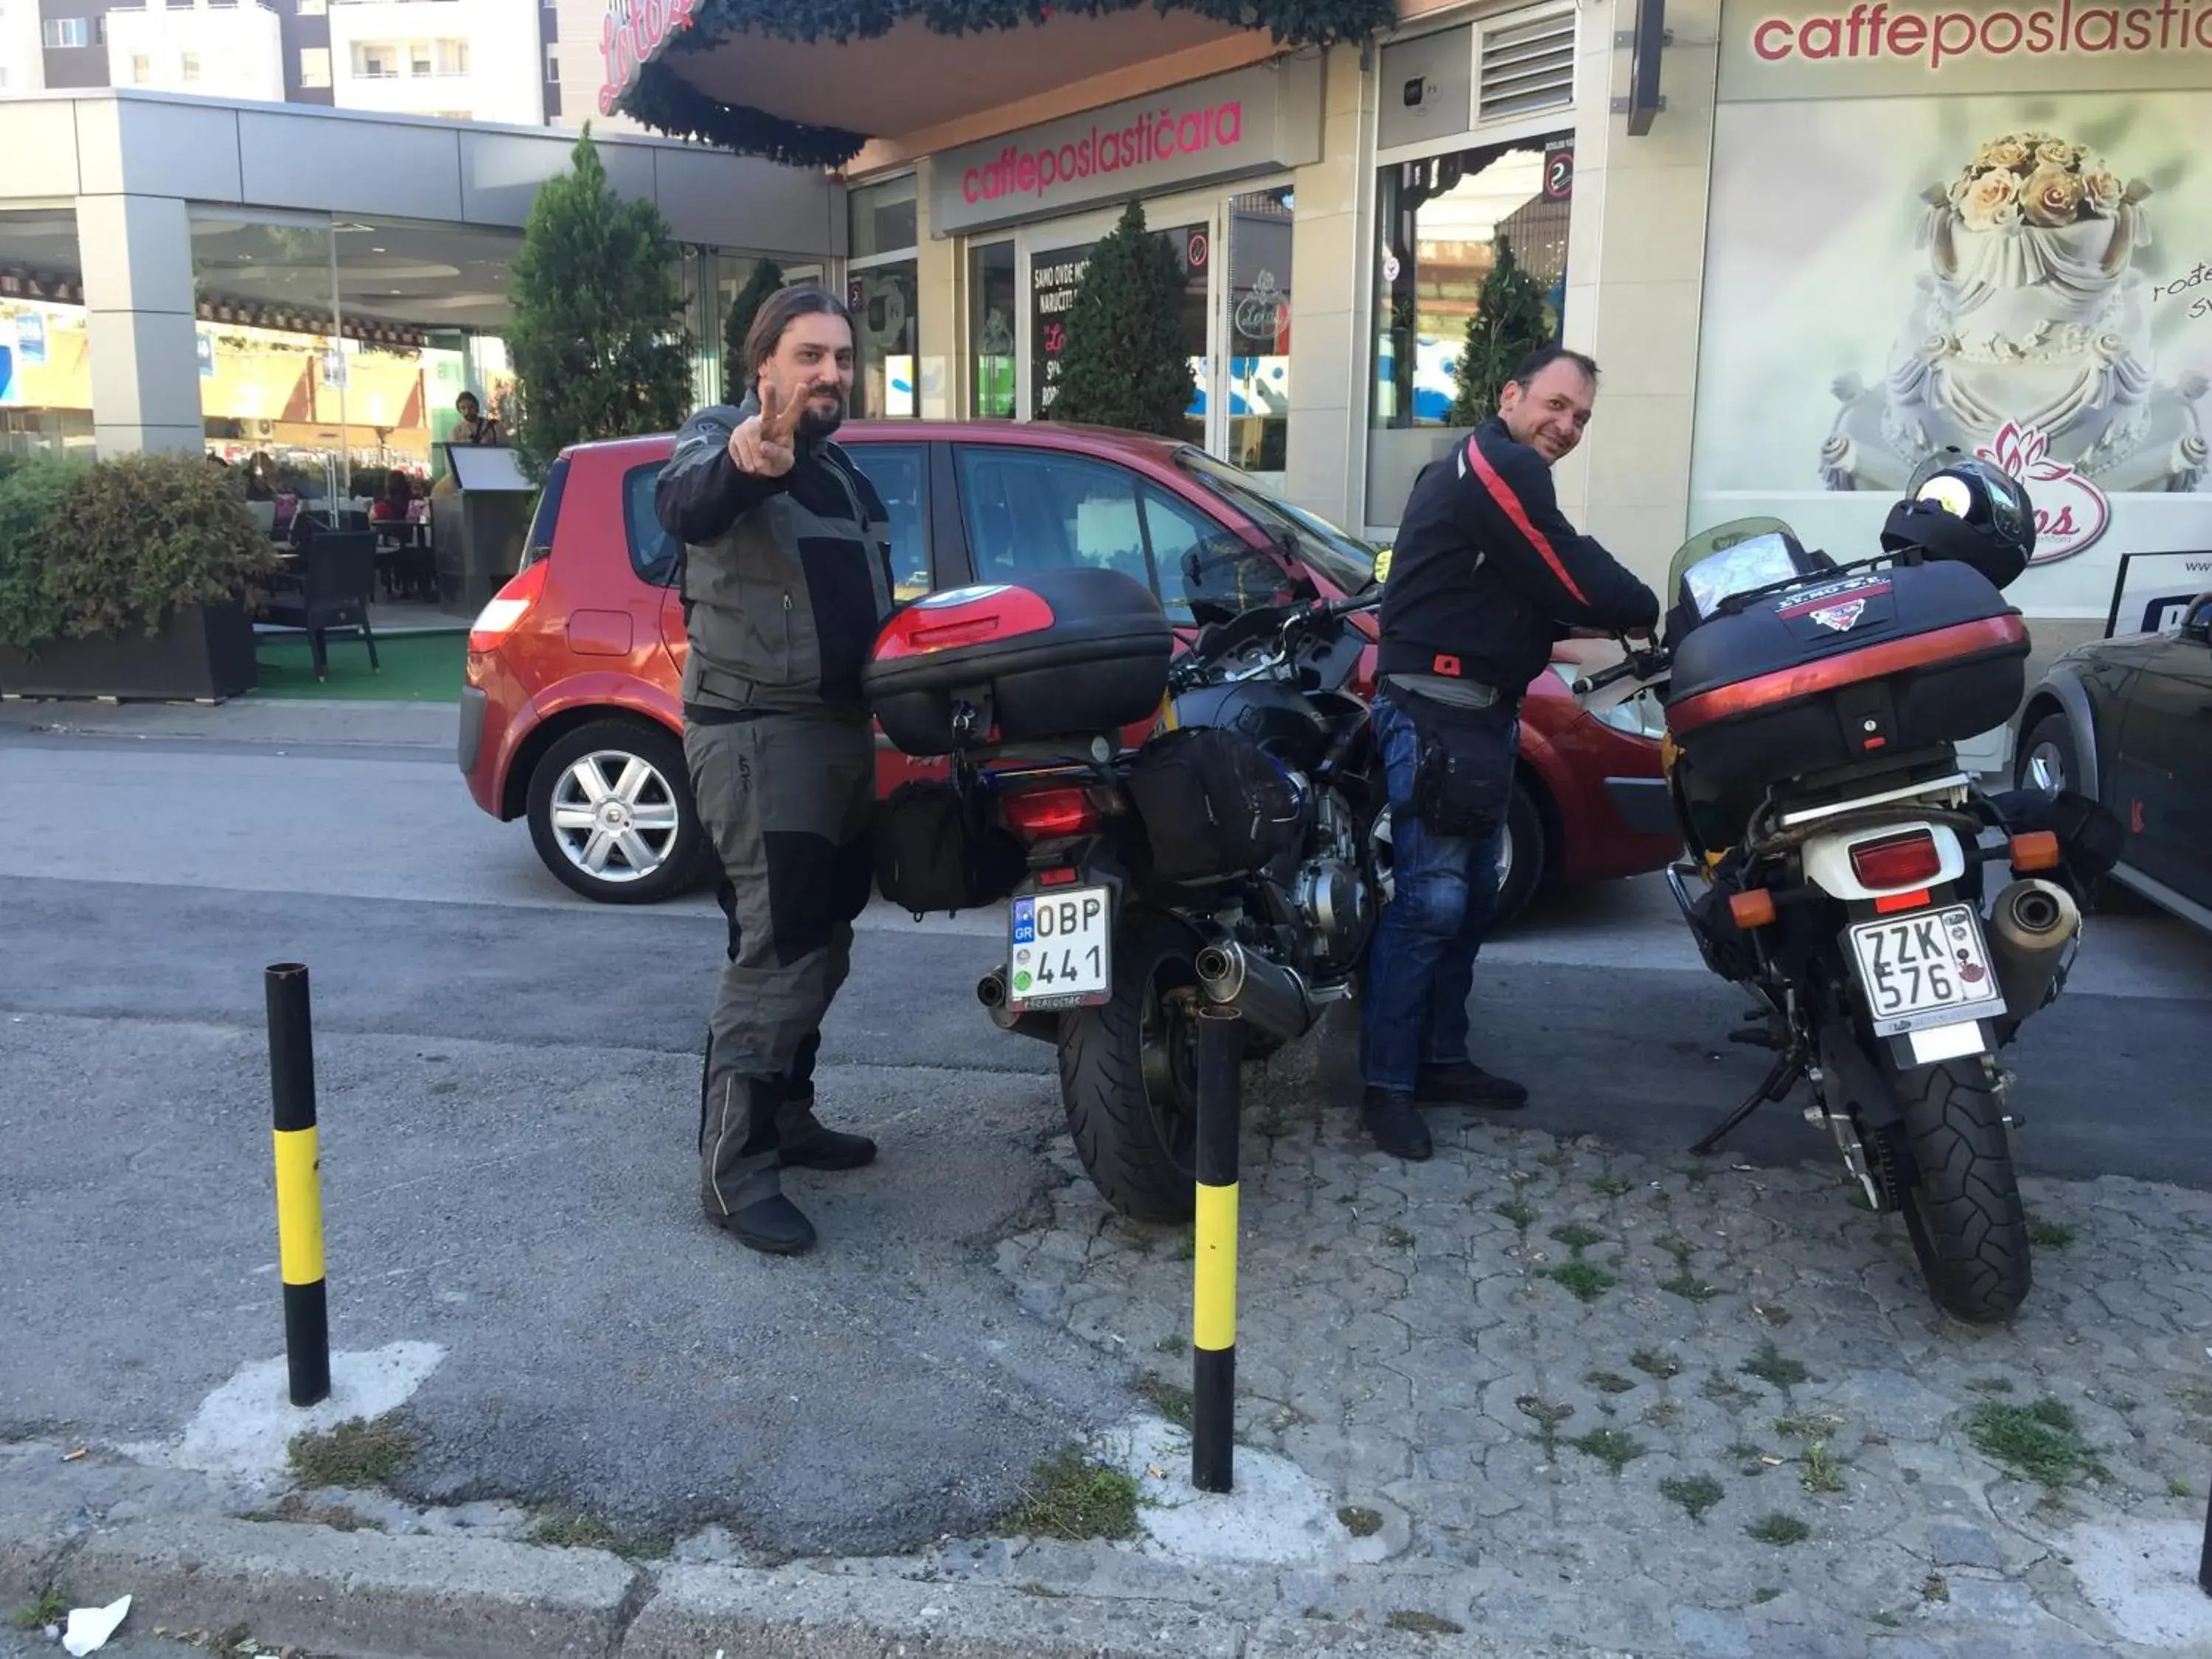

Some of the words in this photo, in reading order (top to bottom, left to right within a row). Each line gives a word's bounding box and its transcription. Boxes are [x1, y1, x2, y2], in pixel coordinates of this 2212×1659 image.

[963, 100, 1242, 205] caffeposlastičara
[1015, 927, 1032, 940] GR
[1037, 898, 1101, 937] OBP
[1037, 945, 1100, 984] 441
[1865, 921, 1944, 968] ZZK
[1877, 963, 1952, 1009] 576
